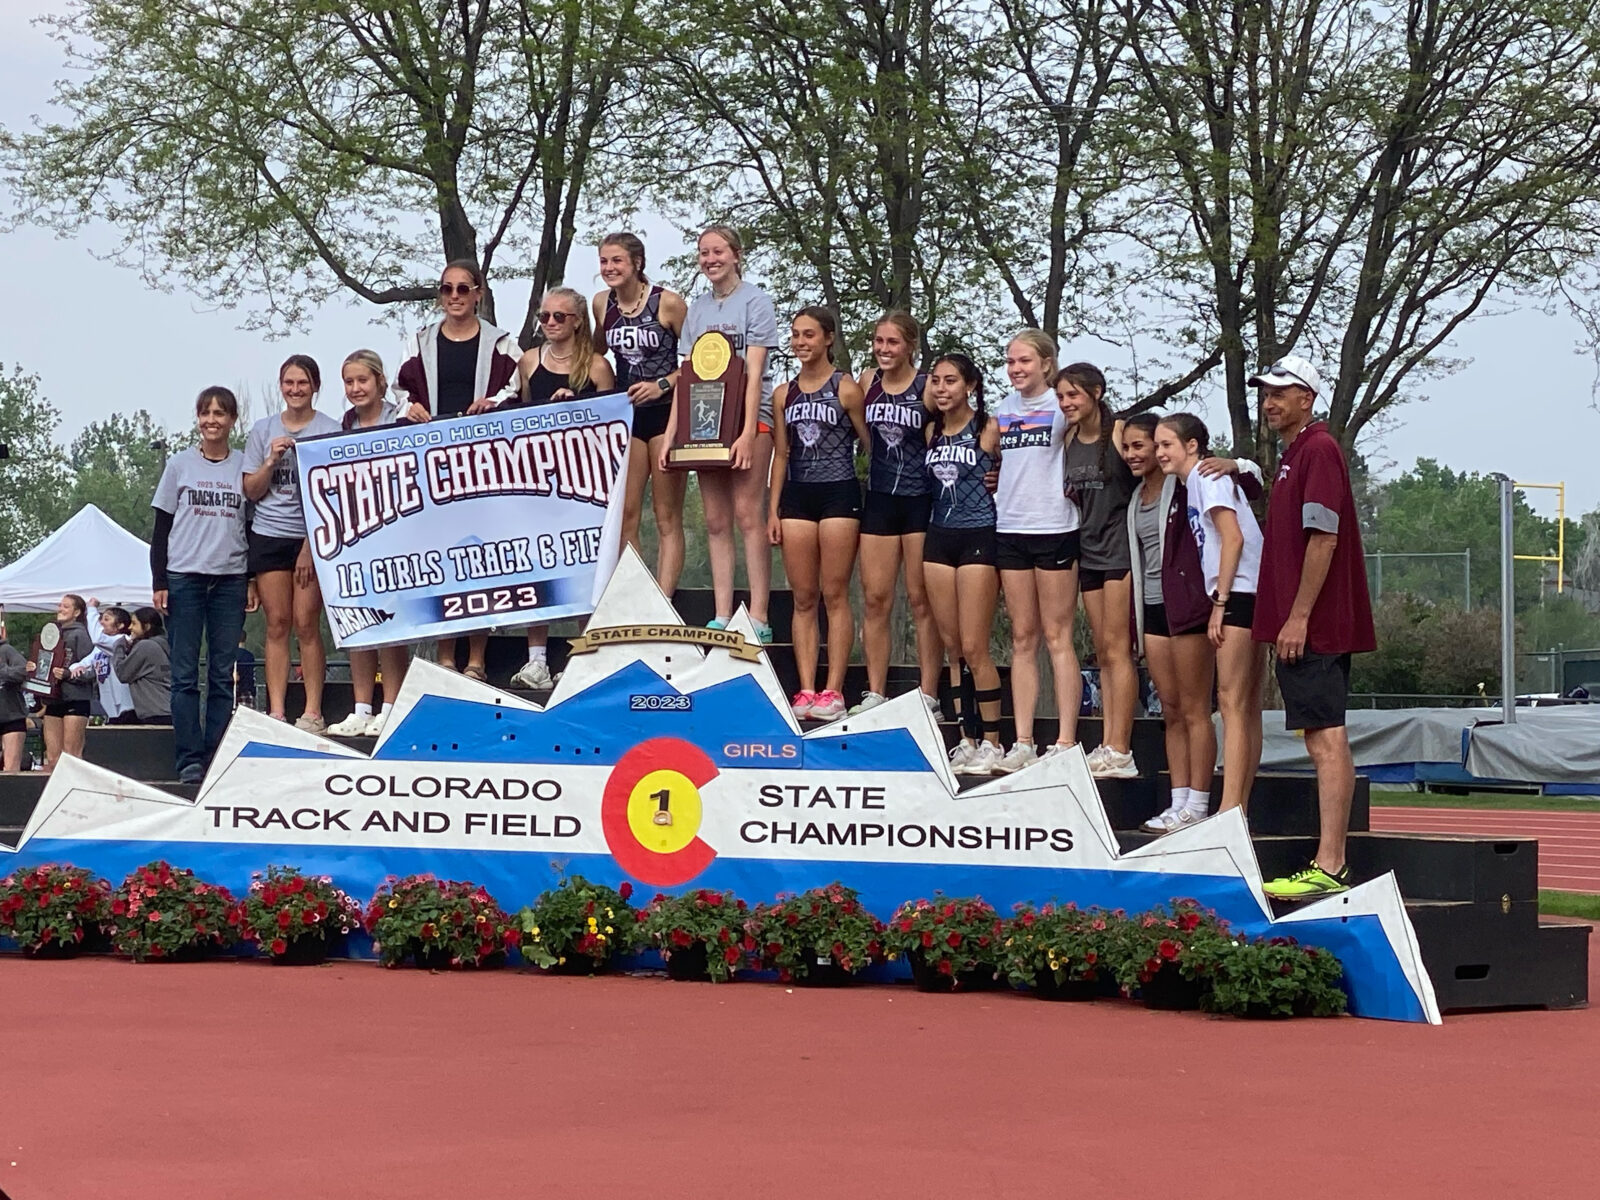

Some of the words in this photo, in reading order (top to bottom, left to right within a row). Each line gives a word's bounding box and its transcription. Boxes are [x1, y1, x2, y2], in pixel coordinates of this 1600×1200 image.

[606, 327, 660, 348] MENO
[623, 328, 635, 350] 5
[785, 402, 837, 426] MERINO
[866, 402, 922, 429] MERINO
[329, 431, 442, 460] COLORADO
[450, 421, 504, 442] HIGH
[511, 409, 600, 432] SCHOOL
[1000, 436, 1017, 445] tes
[1021, 431, 1050, 442] Park
[925, 445, 976, 466] MERINO
[308, 453, 423, 560] STATE
[336, 560, 368, 600] 1A
[371, 549, 445, 594] GIRLS
[448, 537, 534, 583] TRACK
[537, 533, 557, 570] &
[560, 525, 602, 566] FIE
[443, 586, 539, 618] 2023
[328, 605, 377, 639] CHSAA
[591, 628, 641, 641] STATE
[647, 627, 738, 645] CHAMPION
[631, 695, 691, 709] 2023
[723, 744, 796, 758] GIRLS
[324, 774, 563, 801] COLORADO
[758, 785, 886, 810] STATE
[204, 806, 352, 831] TRACK
[361, 810, 451, 834] AND
[465, 813, 582, 838] FIELD
[739, 820, 1075, 853] CHAMPIONSHIPS
